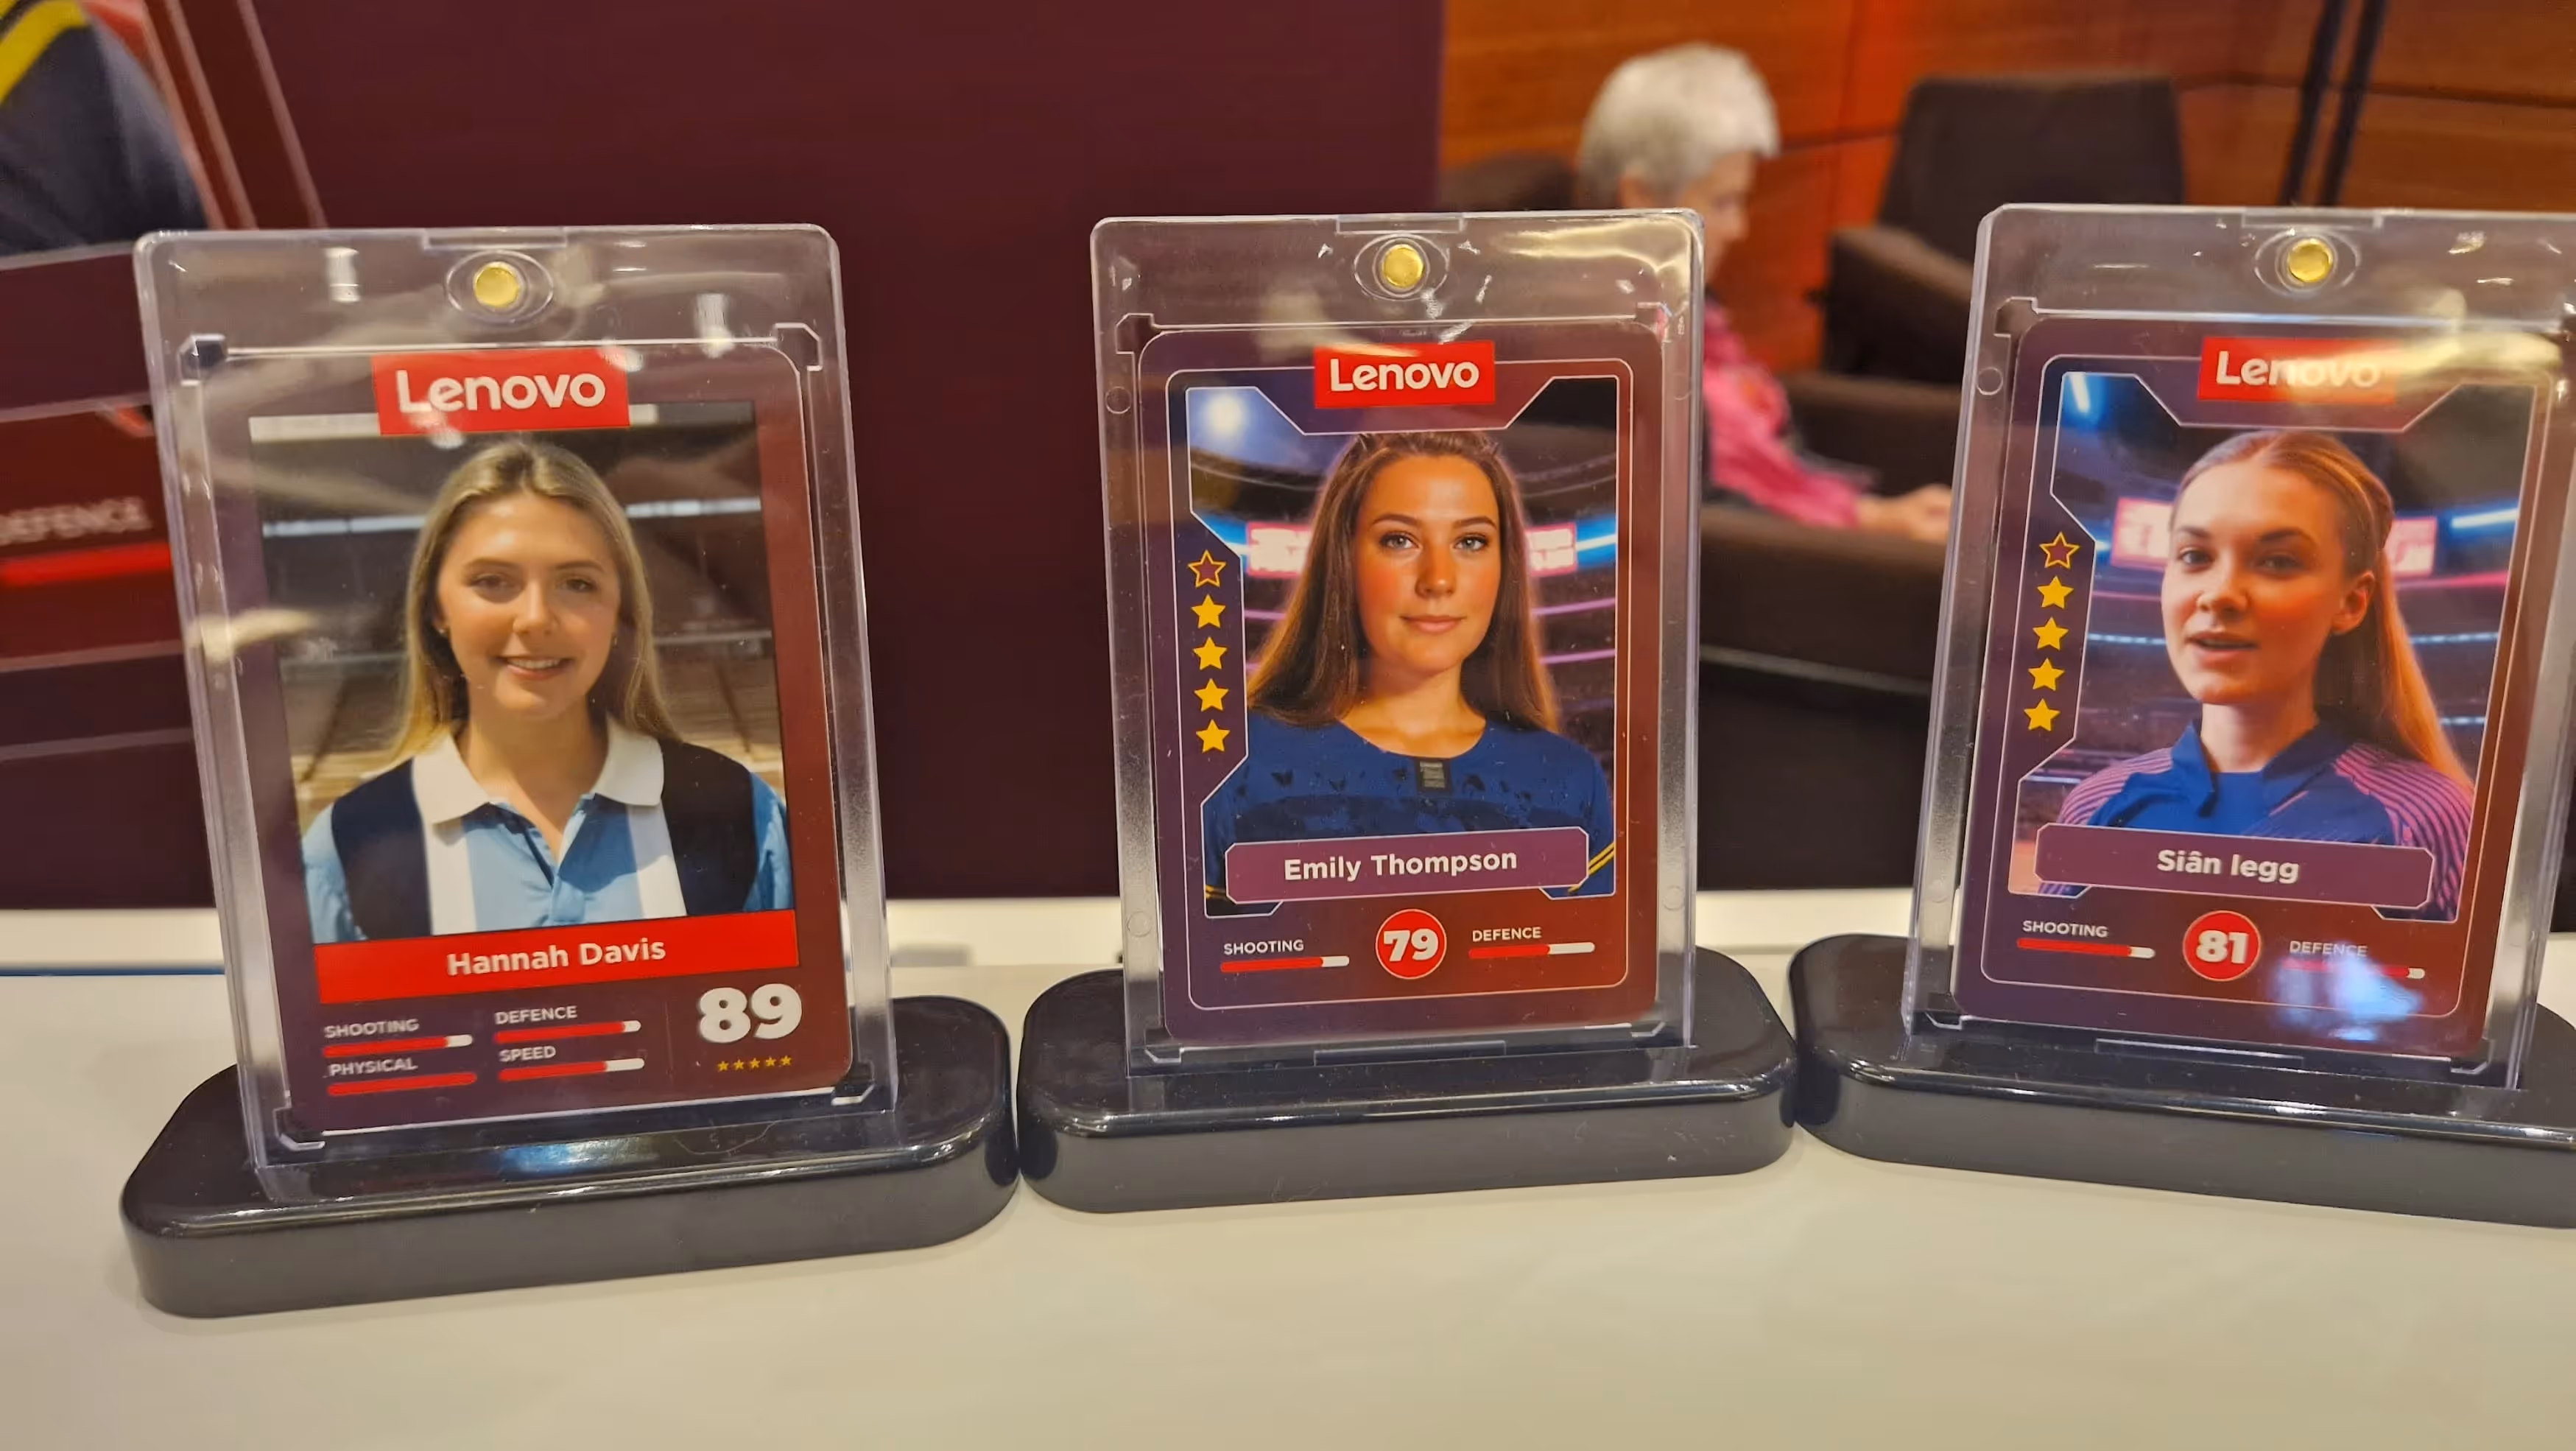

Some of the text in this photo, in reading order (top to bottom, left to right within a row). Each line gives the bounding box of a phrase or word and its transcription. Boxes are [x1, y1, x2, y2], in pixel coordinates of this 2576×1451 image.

[1330, 358, 1480, 392] Lenovo
[2216, 350, 2382, 388] Lenovo
[395, 369, 606, 412] Lenovo
[1284, 851, 1518, 882] Emily Thompson
[2156, 849, 2222, 876] Siân
[1471, 926, 1542, 943] DEFENCE
[2021, 919, 2109, 938] SHOOTING
[446, 937, 666, 977] Hannah Davis
[1222, 938, 1305, 956] SHOOTING
[1382, 928, 1439, 962] 79
[2195, 930, 2248, 965] 81
[2289, 940, 2369, 958] DEFENCE
[494, 1005, 578, 1025] DEFENCE
[697, 982, 803, 1044] 89
[323, 1018, 420, 1039] SHOOTING
[328, 1057, 418, 1078] PHYSICAL
[498, 1044, 557, 1064] SPEED
